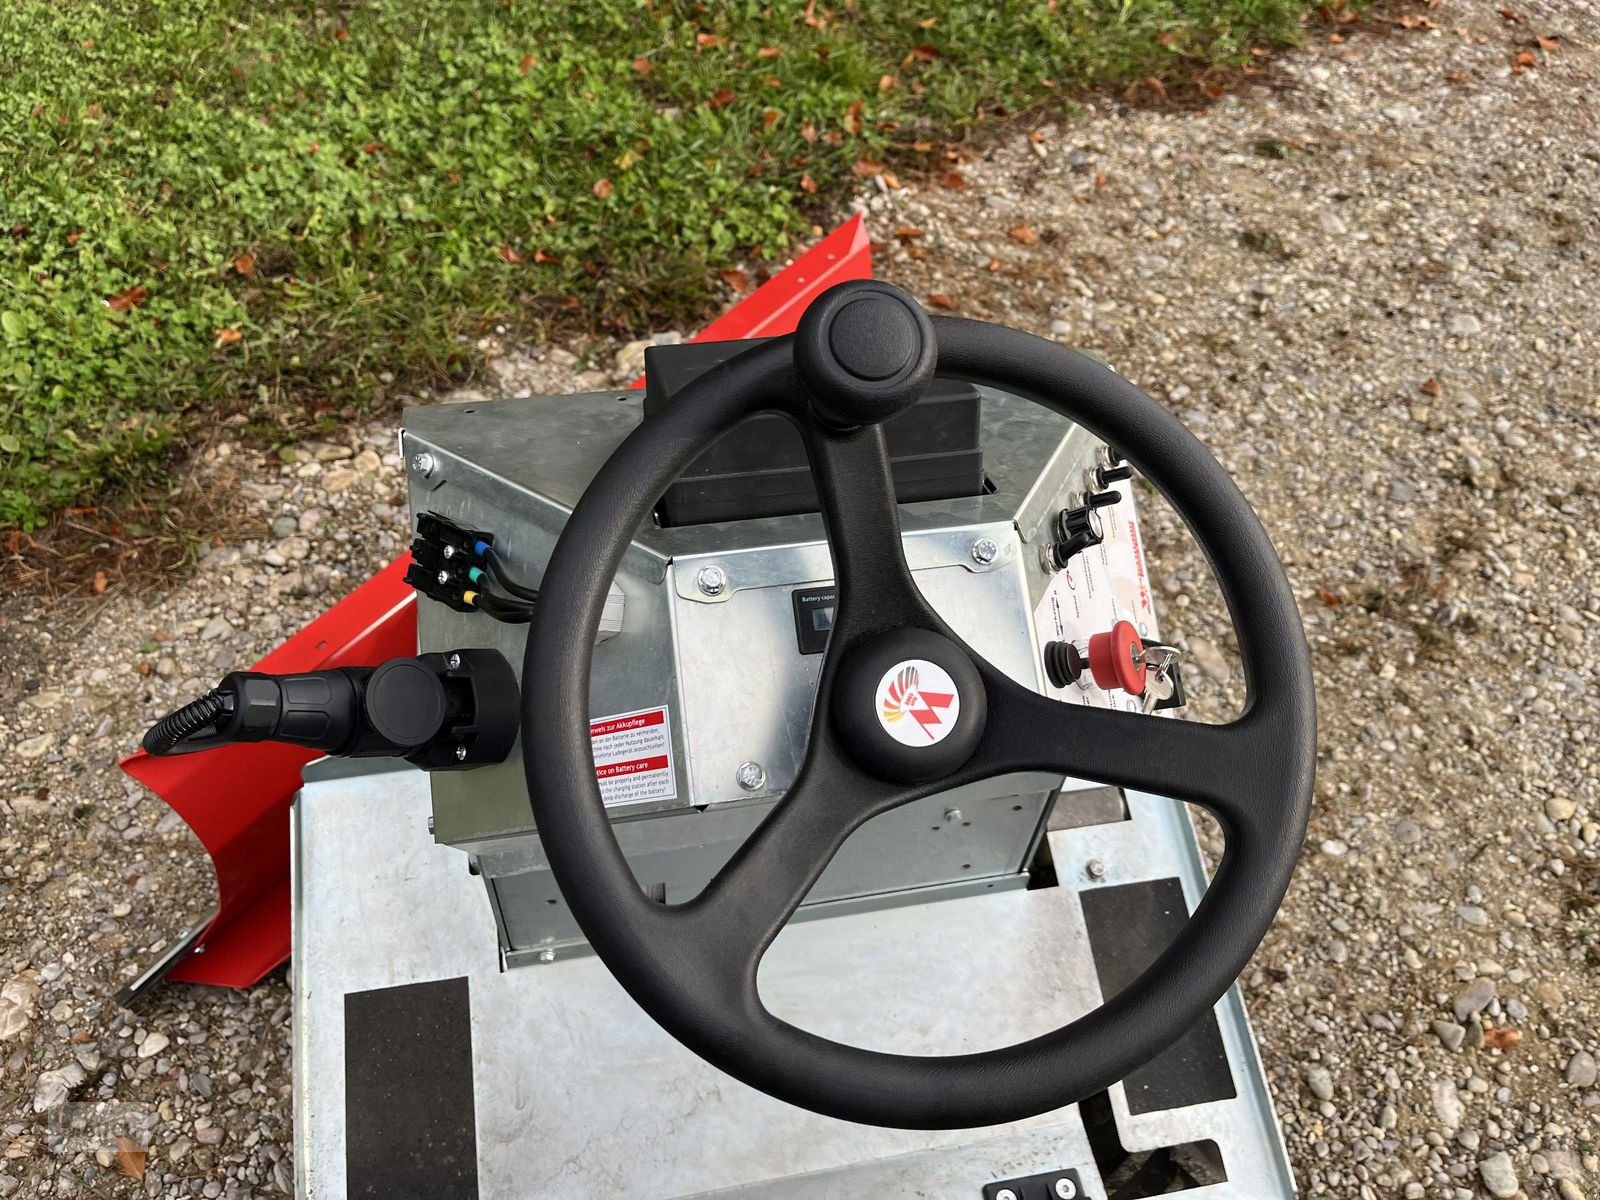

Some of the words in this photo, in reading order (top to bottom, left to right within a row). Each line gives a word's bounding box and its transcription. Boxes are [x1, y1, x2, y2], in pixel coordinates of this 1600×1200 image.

[616, 719, 645, 729] Akkupflege
[613, 732, 629, 741] Batterie
[614, 742, 624, 750] jeder
[616, 764, 635, 773] Battery
[615, 776, 632, 784] properly
[642, 771, 668, 780] permanently
[614, 791, 633, 800] discharge
[648, 786, 666, 795] battery!
